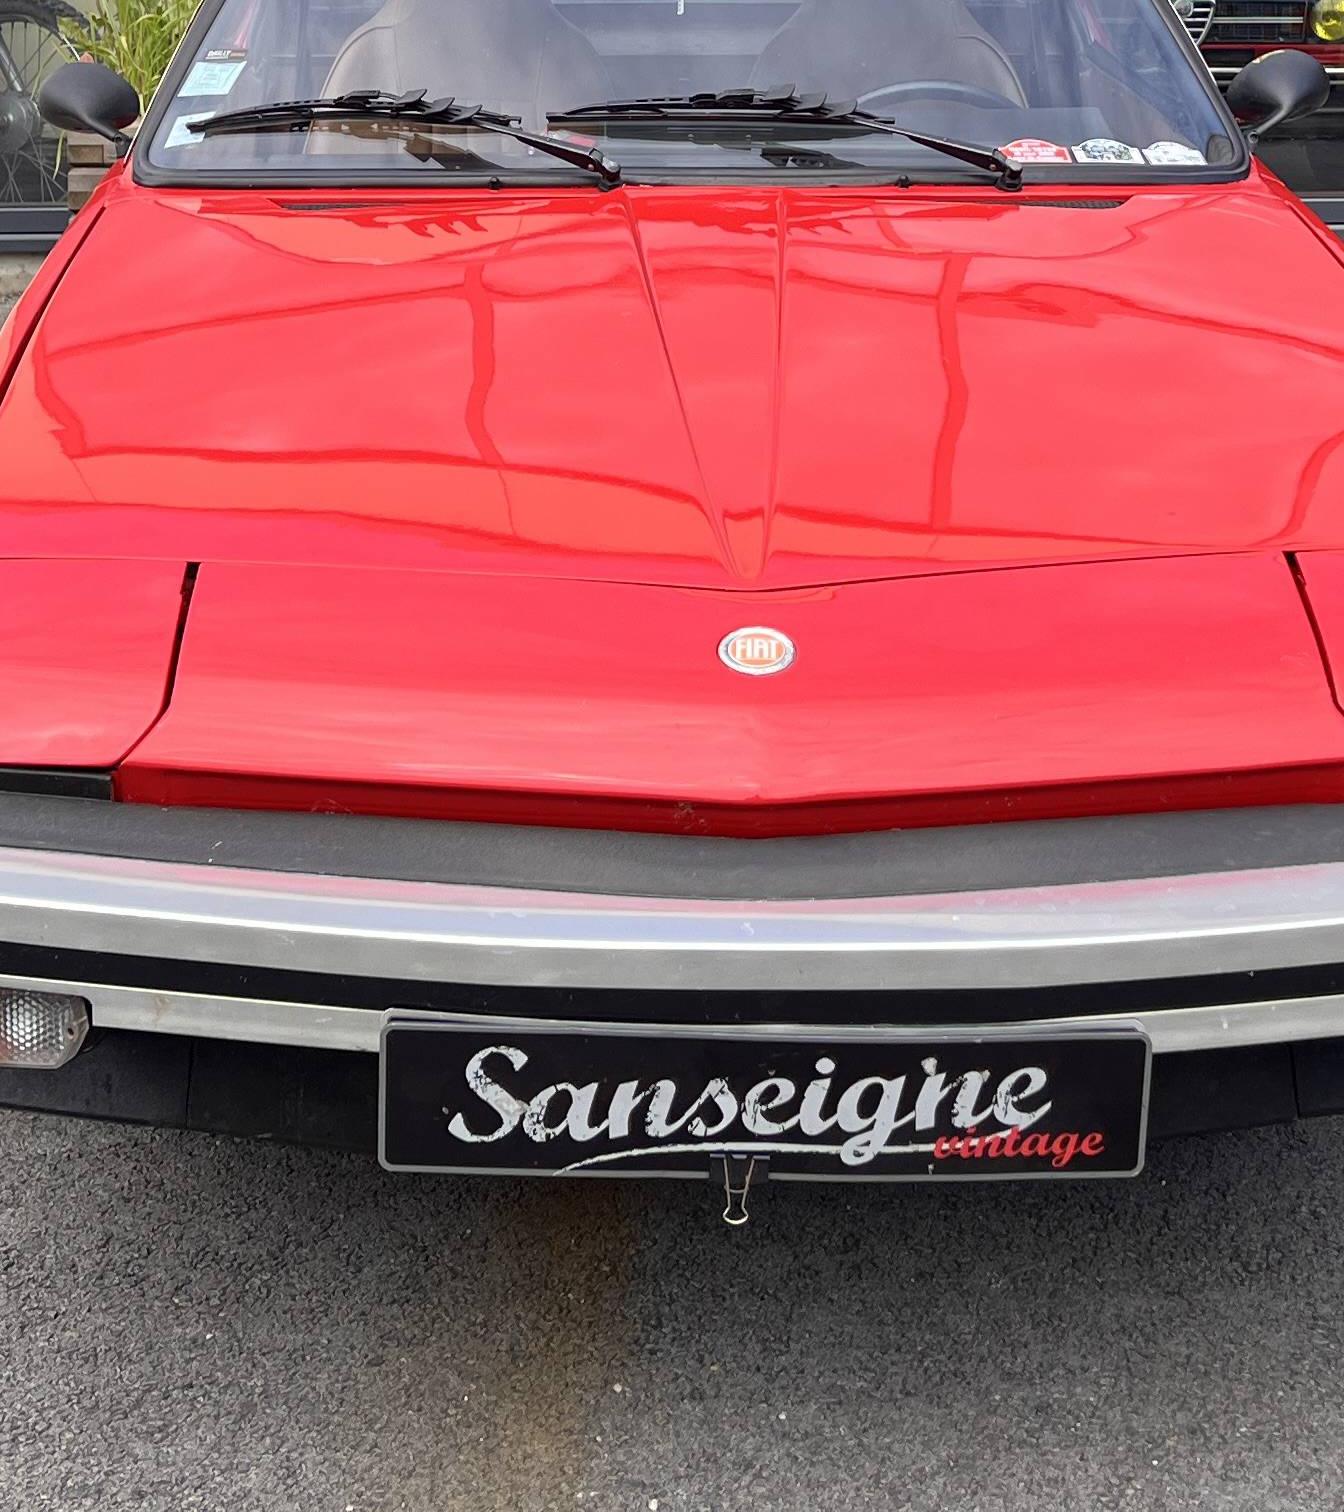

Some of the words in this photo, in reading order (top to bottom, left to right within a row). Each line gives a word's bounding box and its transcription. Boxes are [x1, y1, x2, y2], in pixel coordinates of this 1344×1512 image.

[736, 639, 778, 658] FIAT
[447, 1044, 1053, 1166] Sanseigne
[932, 1124, 1105, 1168] vintage
